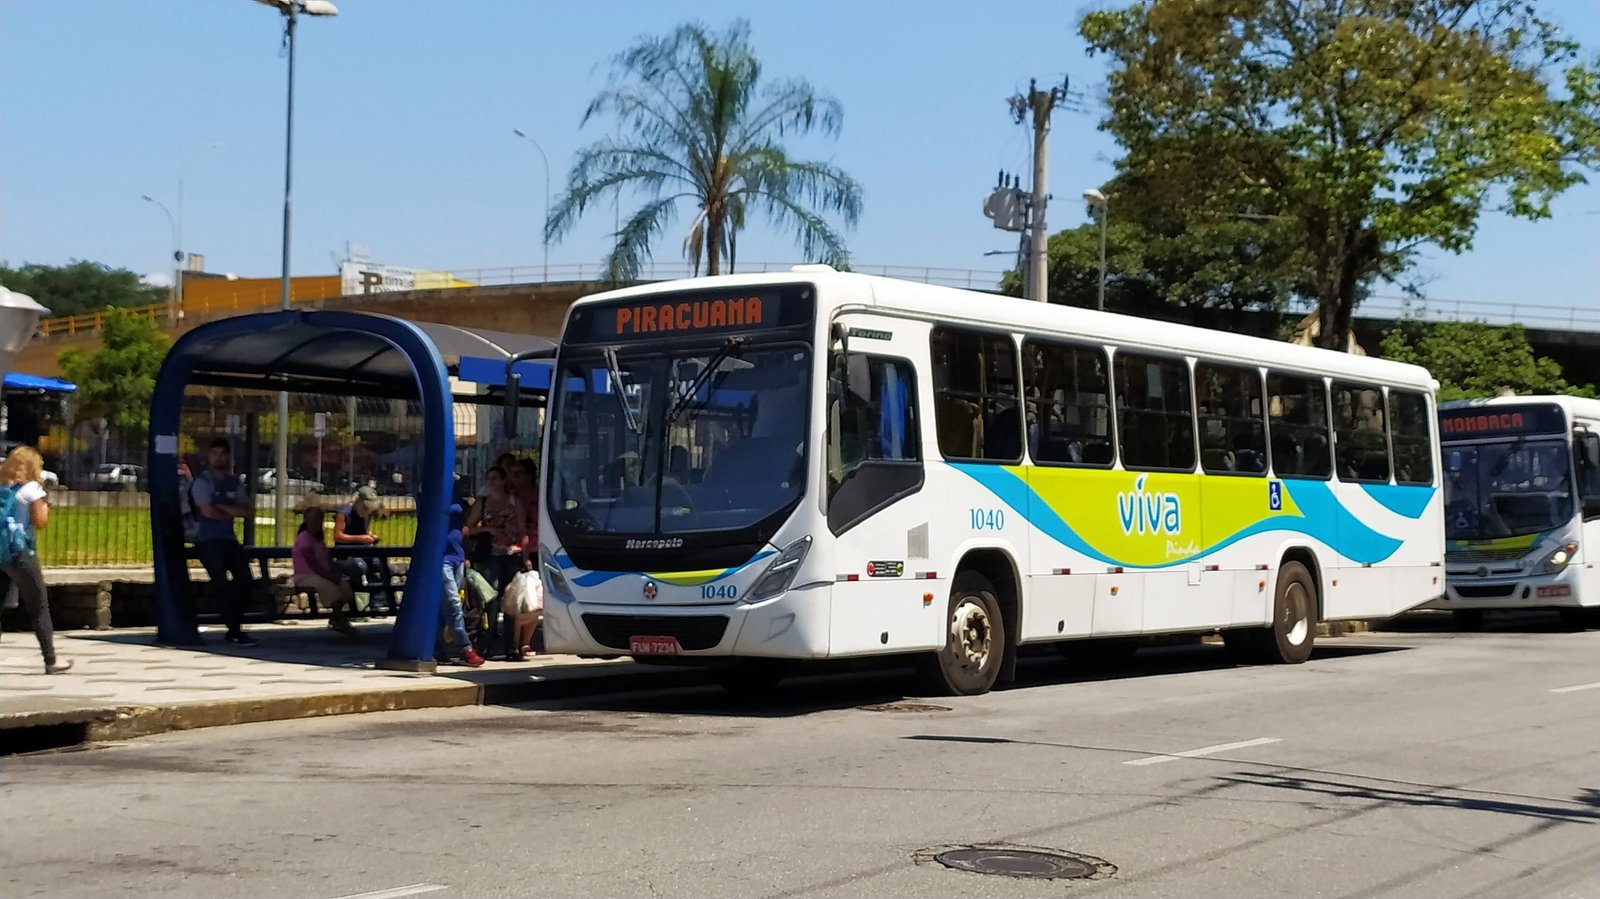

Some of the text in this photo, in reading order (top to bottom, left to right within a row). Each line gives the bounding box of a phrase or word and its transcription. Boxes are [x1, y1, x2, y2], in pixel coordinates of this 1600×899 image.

[616, 296, 763, 335] PIRACUAMA
[1443, 413, 1524, 432] MOMBACA
[1118, 474, 1182, 536] viva
[970, 508, 1005, 531] 1040
[625, 537, 683, 549] Marcopolo
[701, 584, 738, 600] 1040
